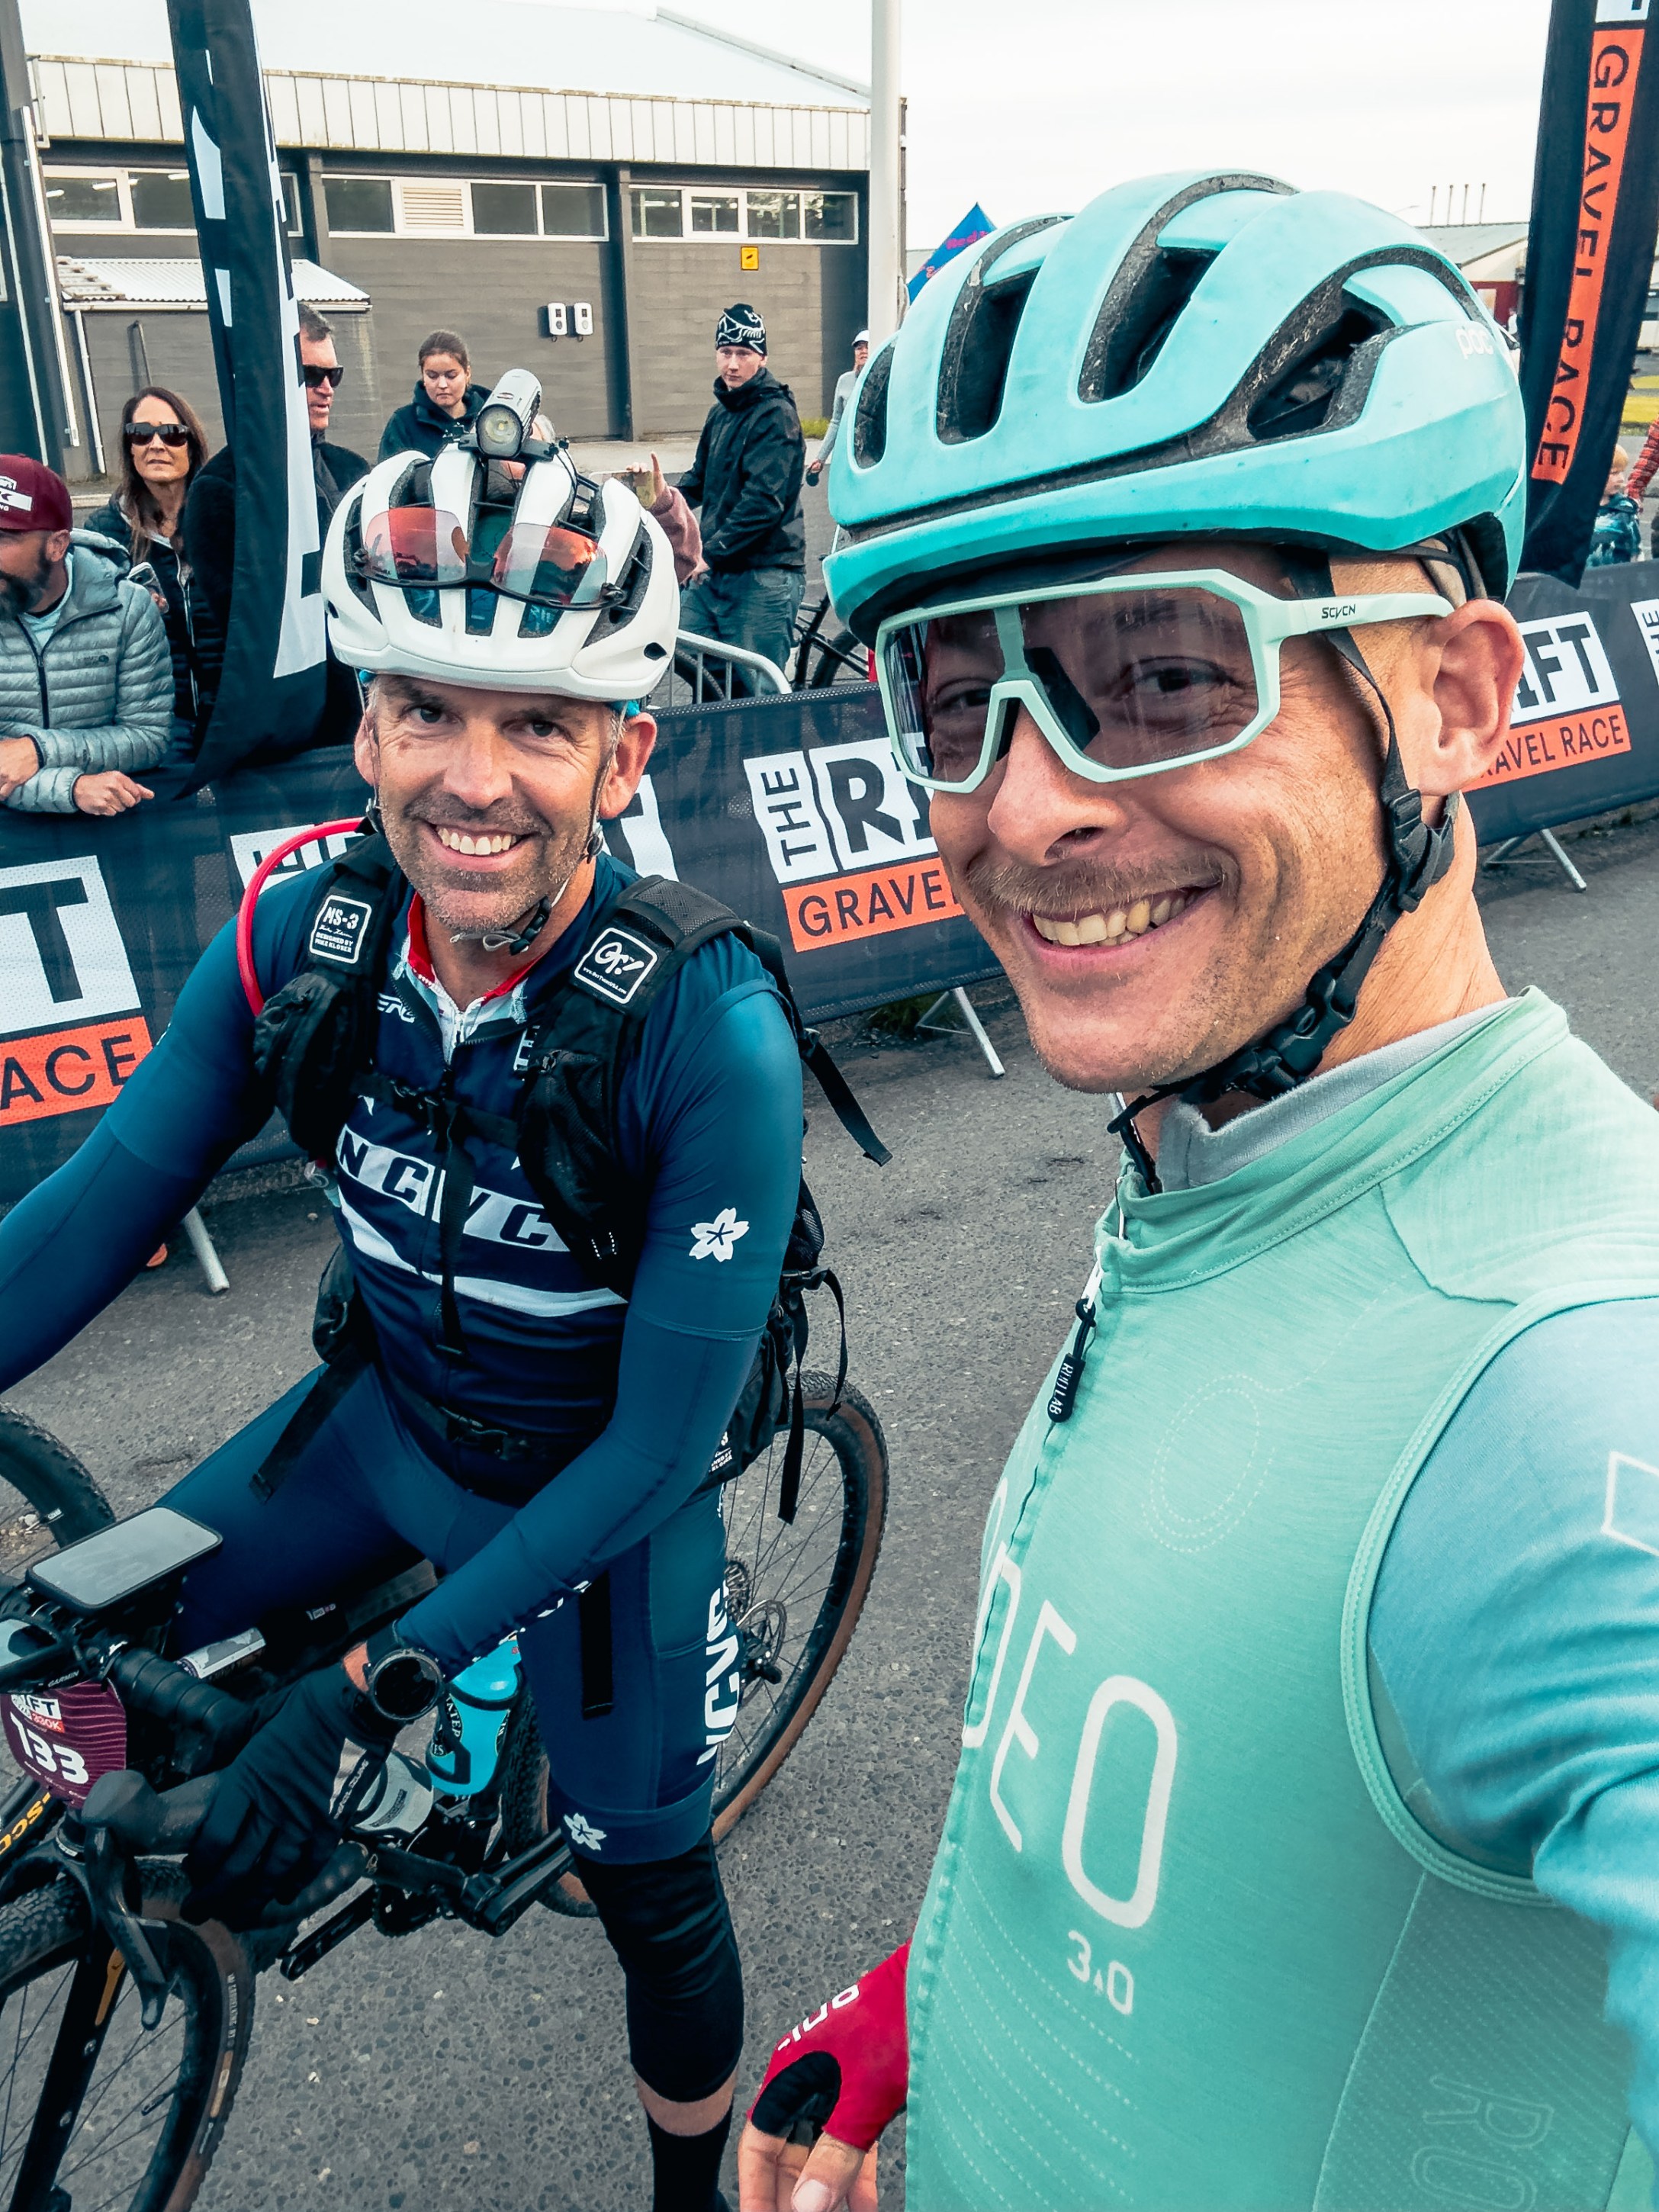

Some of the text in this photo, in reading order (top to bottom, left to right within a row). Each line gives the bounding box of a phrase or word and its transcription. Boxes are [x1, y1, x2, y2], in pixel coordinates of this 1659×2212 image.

[1559, 714, 1624, 758] RACE
[760, 767, 818, 866] THE
[798, 870, 960, 937] GRAVE
[10, 1711, 89, 1785] 133
